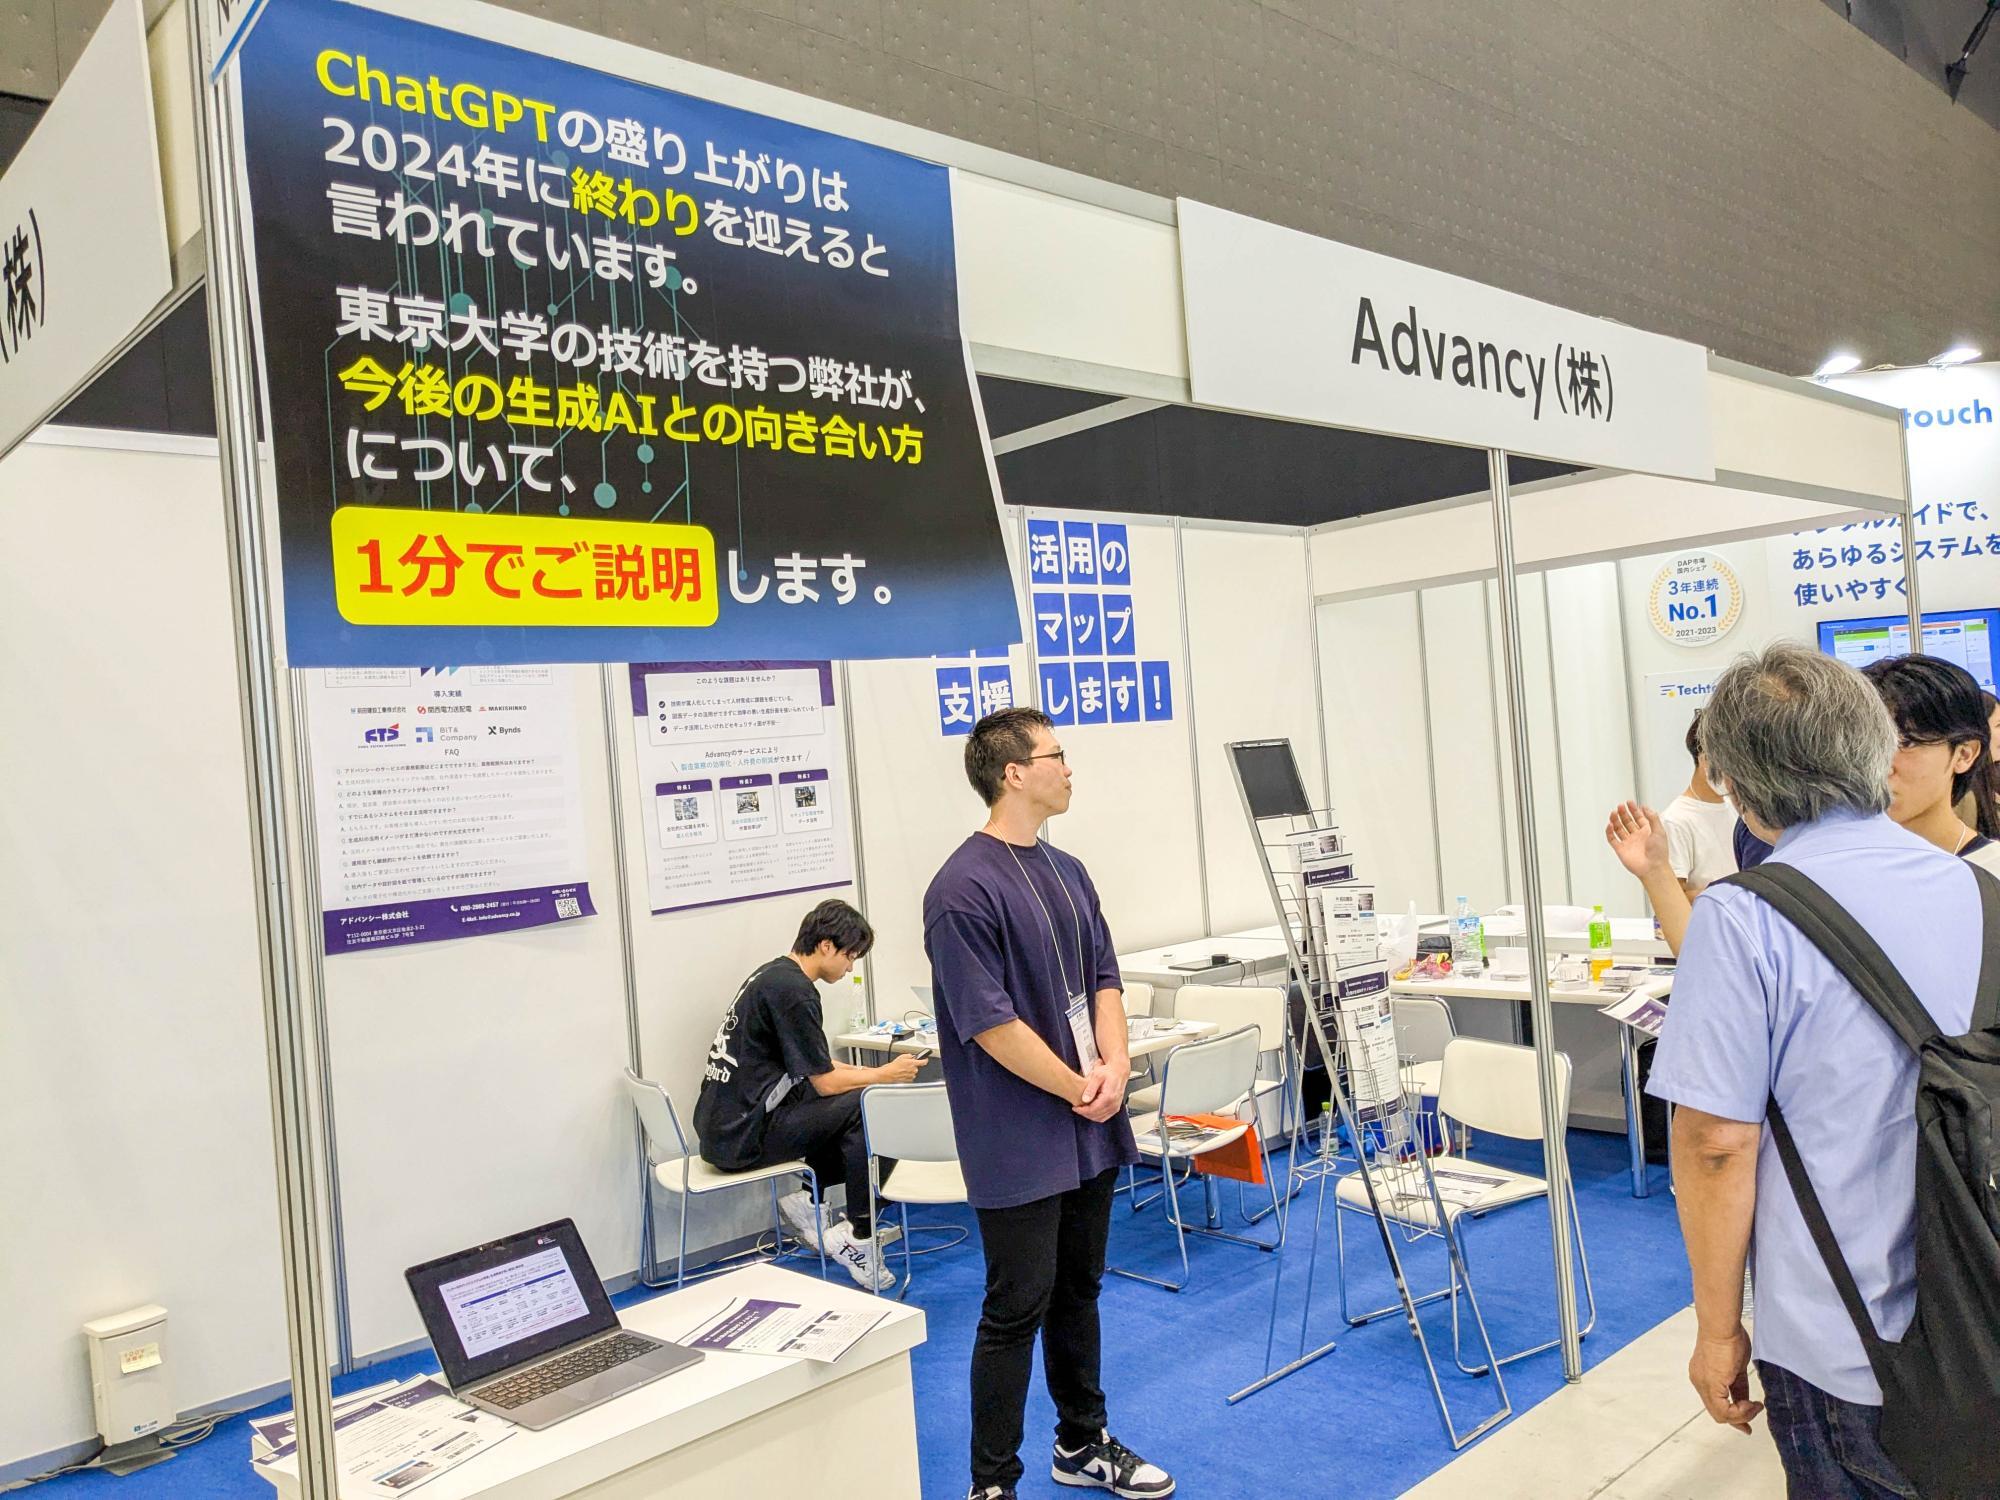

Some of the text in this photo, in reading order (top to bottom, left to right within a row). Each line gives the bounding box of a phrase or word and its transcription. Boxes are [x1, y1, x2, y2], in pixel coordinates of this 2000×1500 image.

[322, 118, 889, 277] 2024年に終わりを迎えると
[326, 181, 698, 295] 言われています。
[335, 286, 926, 414] 東京大学の技術を持つ弊社が、
[338, 357, 923, 465] 今後の生成AIとの向き合い方
[347, 428, 578, 495] について、
[355, 534, 893, 607] 1分でご説明 します。
[1031, 534, 1127, 575] 活用の
[1668, 578, 1720, 596] 3年連続
[1038, 607, 1132, 644] マップ
[1668, 594, 1717, 622] No.1
[1676, 626, 1717, 638] 2021-2023
[433, 689, 462, 698] 導入実績
[499, 725, 522, 735] Bynds
[444, 748, 460, 757] FAQ
